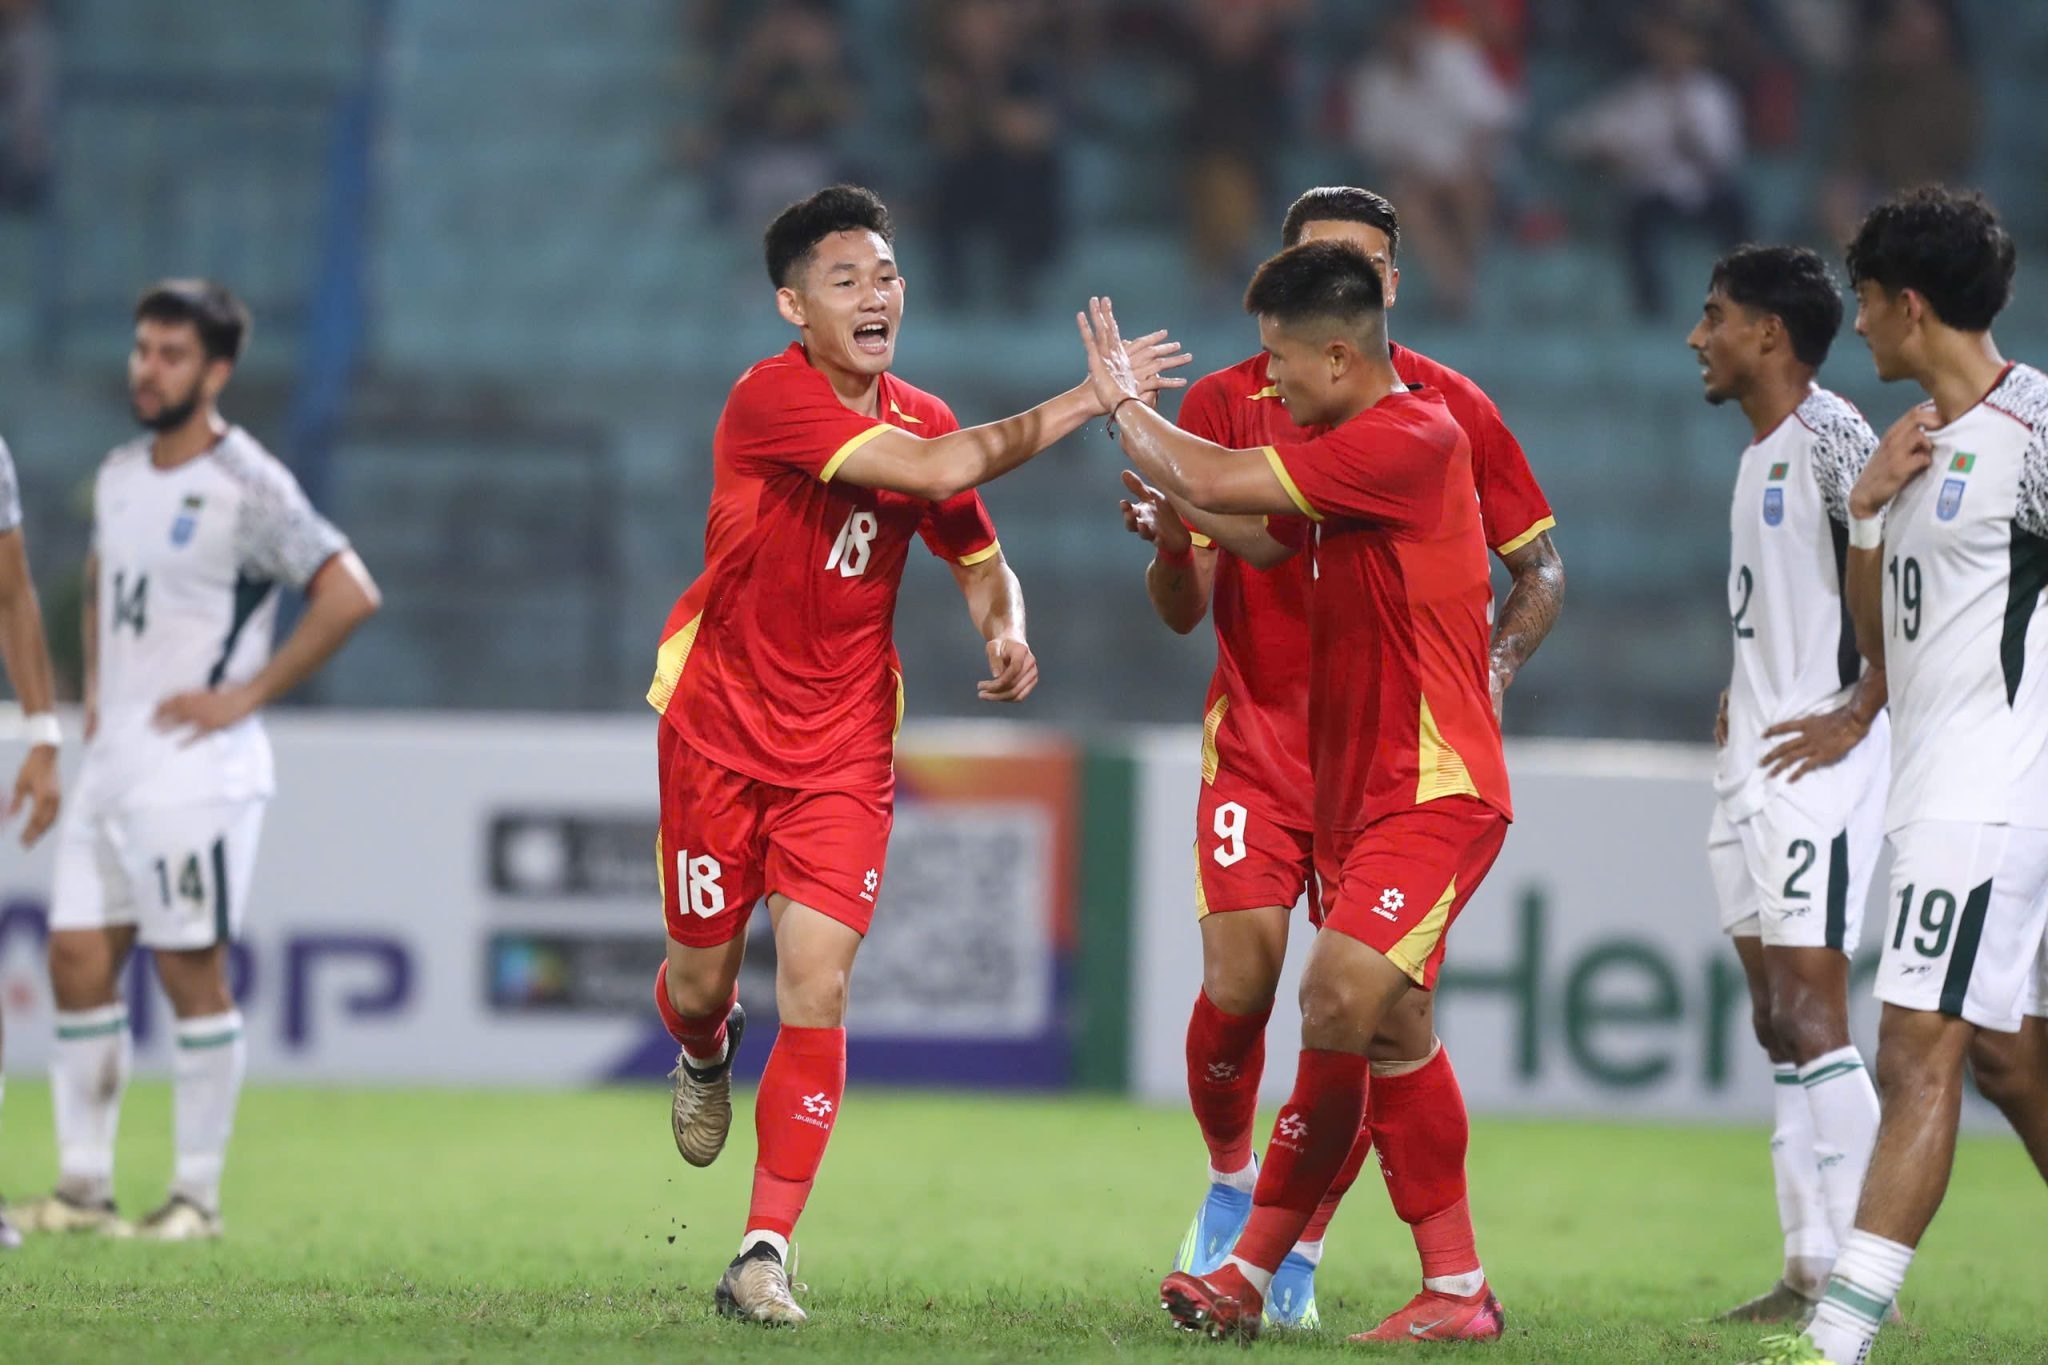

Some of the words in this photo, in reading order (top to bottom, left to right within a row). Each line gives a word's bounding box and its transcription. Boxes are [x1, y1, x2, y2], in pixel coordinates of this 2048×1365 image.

[824, 504, 878, 578] 18
[113, 569, 148, 636] 14
[1732, 564, 1755, 640] 2
[1889, 554, 1922, 642] 19
[1213, 801, 1248, 868] 9
[1783, 838, 1817, 900] 2
[154, 853, 204, 907] 14
[676, 848, 726, 920] 18
[1891, 883, 1957, 959] 19
